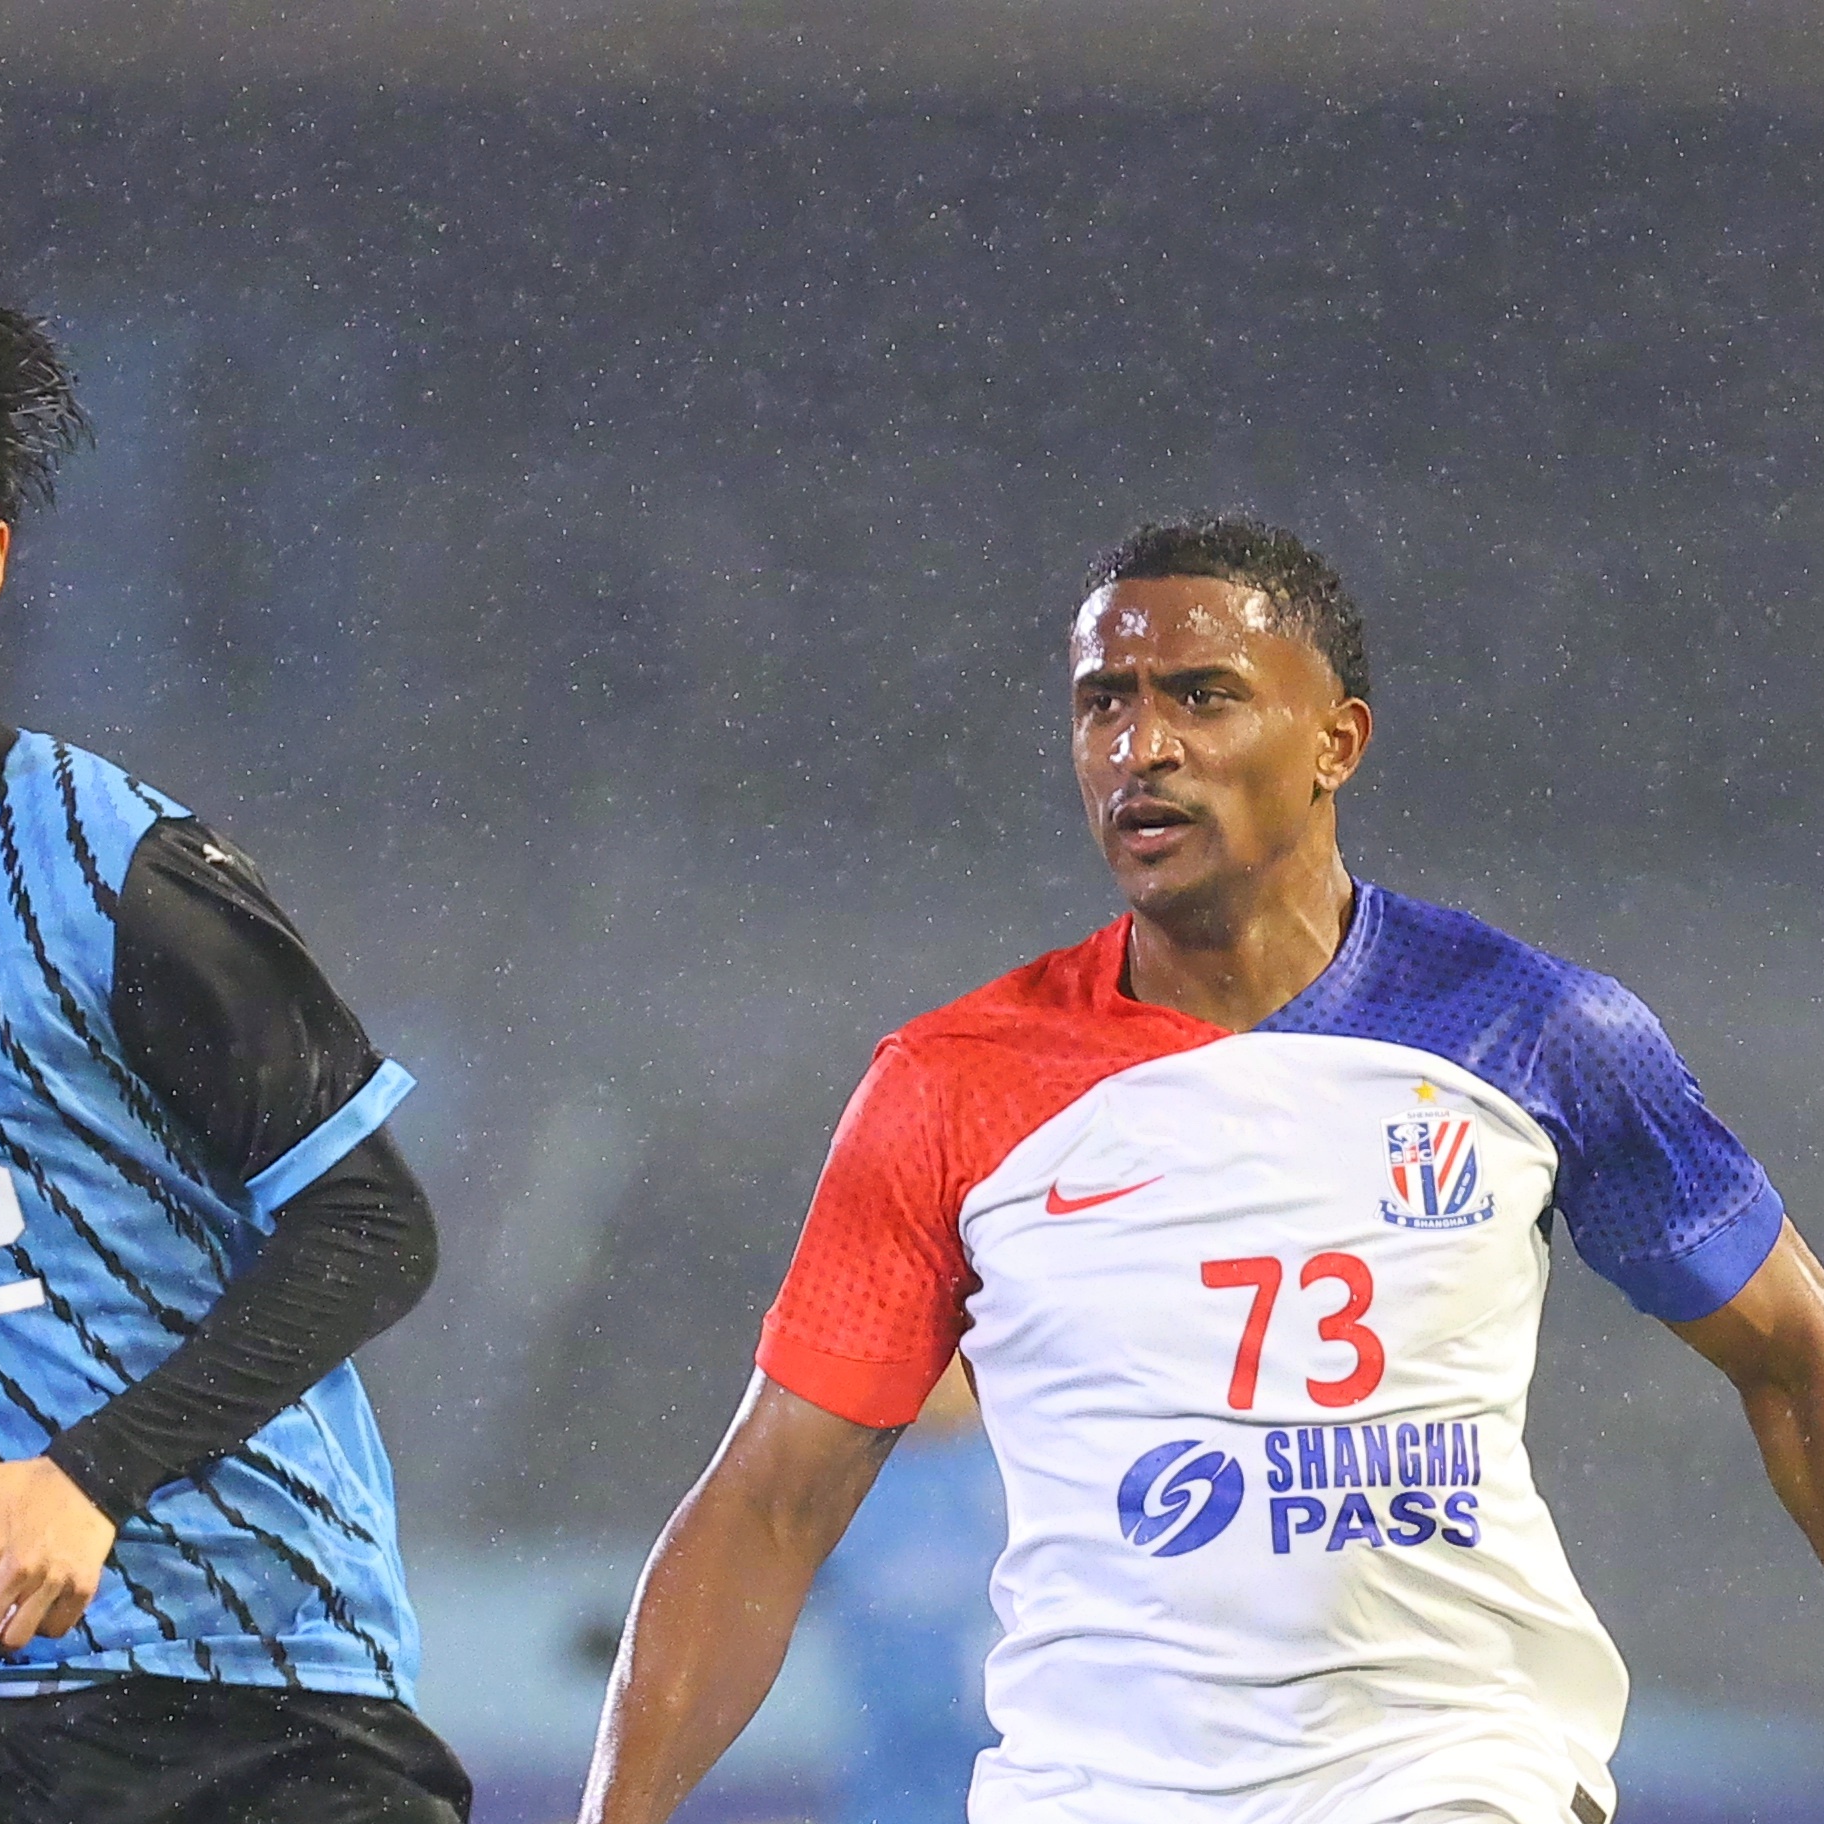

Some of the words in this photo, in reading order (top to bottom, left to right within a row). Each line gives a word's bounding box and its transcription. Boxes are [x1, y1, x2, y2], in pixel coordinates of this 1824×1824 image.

[1413, 1216, 1468, 1229] SHANGHAI
[1200, 1251, 1385, 1410] 73
[1265, 1422, 1481, 1493] SHANGHAI
[1270, 1491, 1481, 1554] PASS
